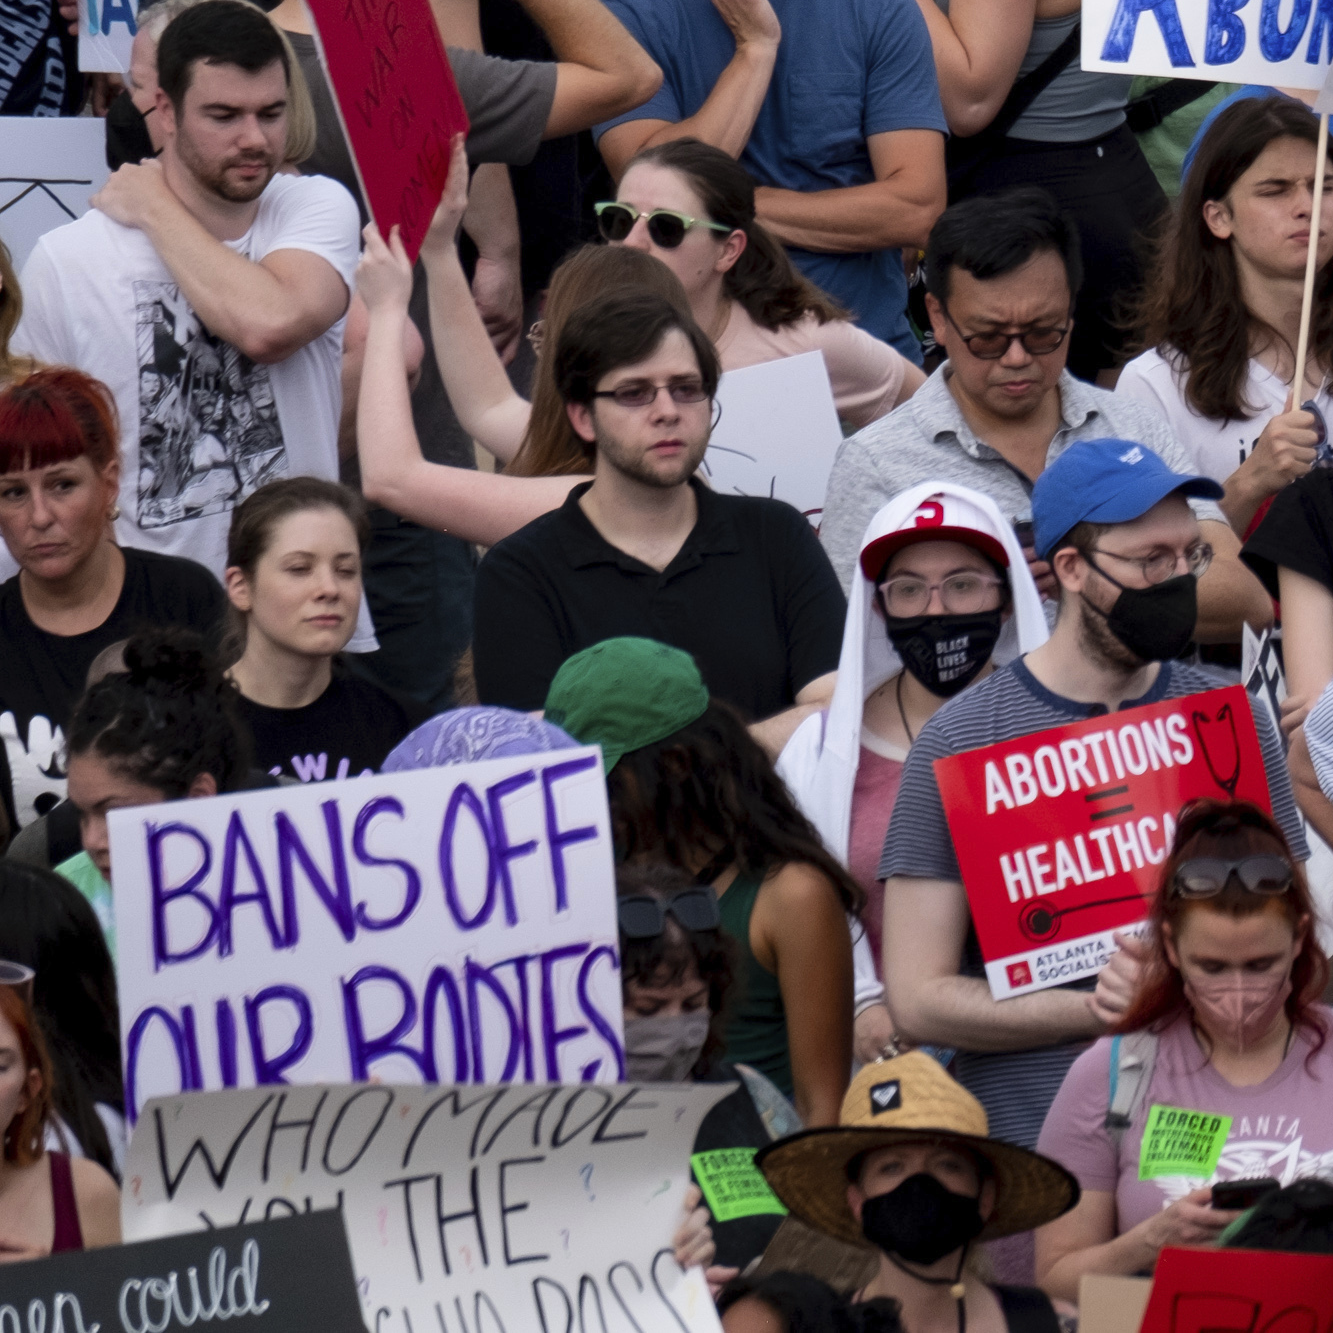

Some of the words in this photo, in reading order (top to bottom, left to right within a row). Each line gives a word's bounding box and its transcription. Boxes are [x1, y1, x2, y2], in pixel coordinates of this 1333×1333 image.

[935, 635, 970, 654] BLACK
[937, 651, 968, 667] LIVES
[984, 713, 1195, 815] ABORTIONS
[145, 794, 423, 971] BANS
[437, 753, 600, 931] OFF
[153, 1085, 395, 1202] WHO
[402, 1085, 660, 1168] MADE
[1156, 1109, 1223, 1134] FORCED
[384, 1155, 550, 1283] THE
[118, 1239, 270, 1329] could
